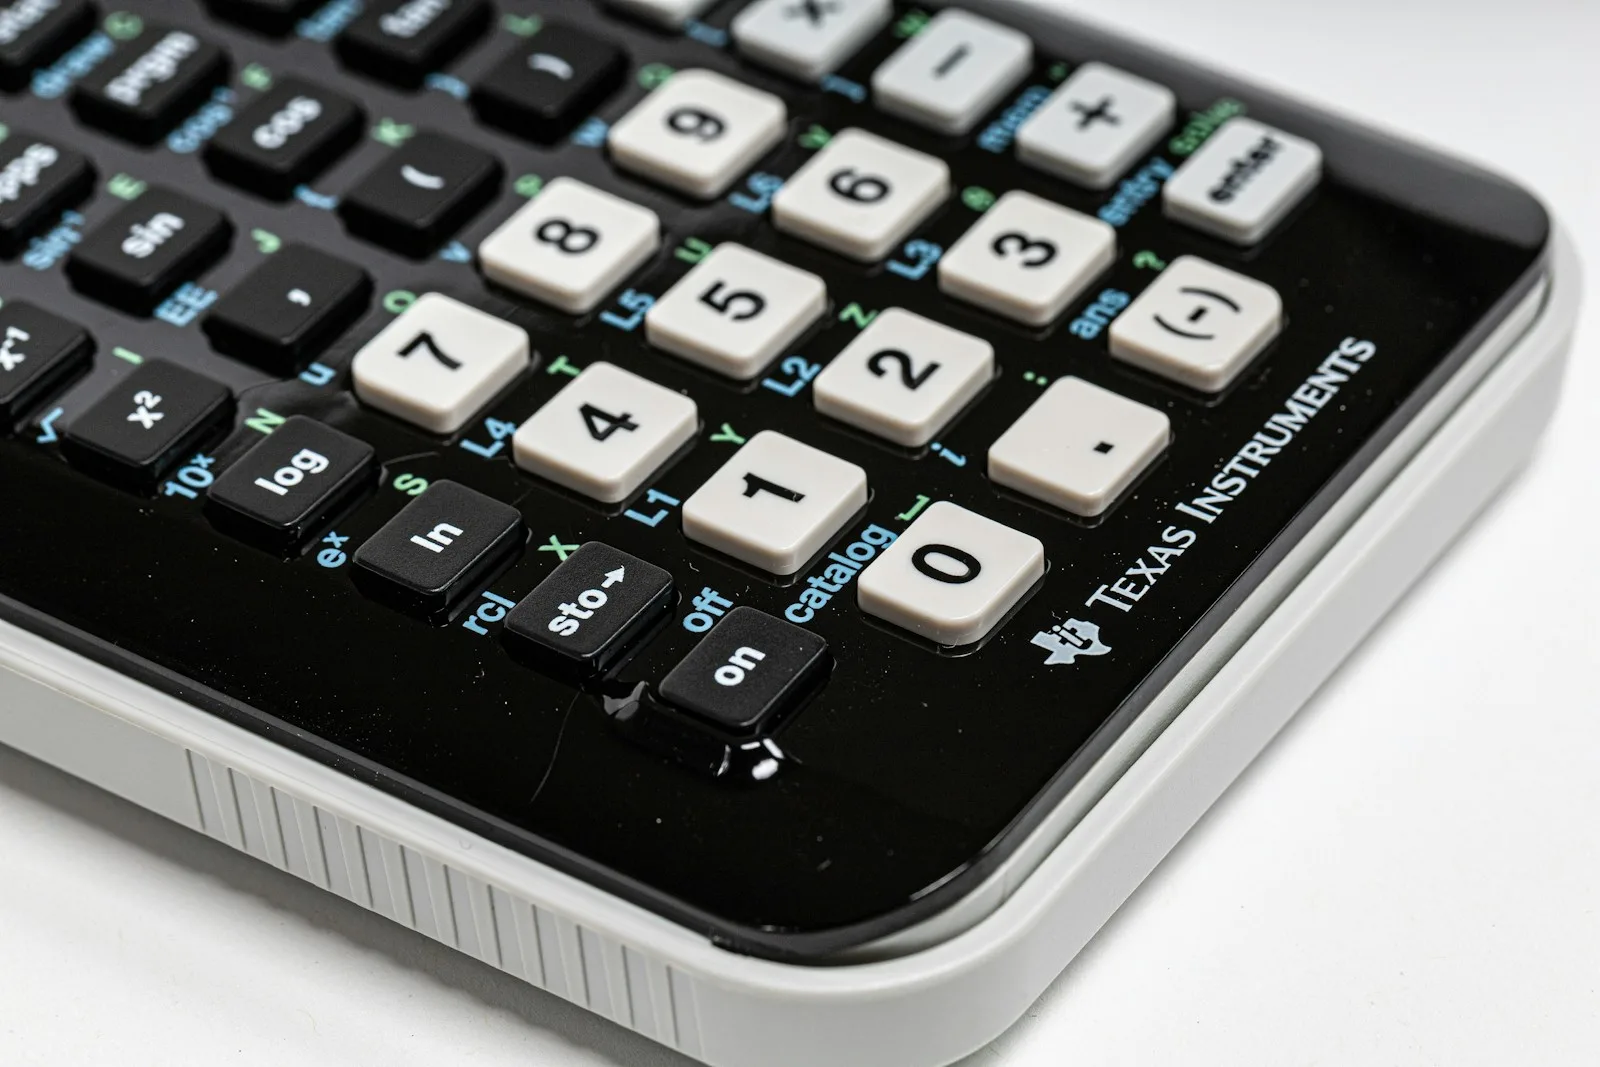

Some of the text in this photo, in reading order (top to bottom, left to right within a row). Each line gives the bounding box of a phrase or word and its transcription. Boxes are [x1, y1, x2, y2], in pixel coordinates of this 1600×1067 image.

[253, 96, 321, 149] cos
[665, 107, 726, 142] 9
[107, 173, 146, 200] E
[827, 167, 892, 206] 6
[1207, 131, 1285, 204] enter
[729, 172, 784, 214] L6
[122, 212, 184, 257] sin
[536, 218, 601, 254] 8
[990, 231, 1057, 268] 3
[887, 239, 943, 280] L3
[153, 282, 218, 327] EE
[601, 289, 655, 331] L5
[697, 281, 766, 322] 5
[839, 303, 878, 328] Z
[1069, 288, 1131, 339] ans
[397, 330, 463, 371] 7
[546, 356, 581, 377] T
[866, 349, 941, 391] 2
[762, 356, 822, 397] L2
[245, 407, 286, 434] N
[460, 416, 517, 459] L4
[579, 403, 640, 442] 4
[710, 423, 746, 446] Y
[254, 448, 329, 496] log
[393, 473, 429, 496] S
[742, 472, 806, 503] 1
[1085, 336, 1377, 613] TEXAS INSTRUMENTS
[624, 488, 680, 528] L1
[410, 521, 464, 553] ln
[538, 535, 581, 561] X
[784, 523, 899, 624] catalog
[911, 543, 981, 584] 0
[462, 591, 516, 635] rcl
[683, 586, 734, 633] off
[714, 645, 766, 686] on
